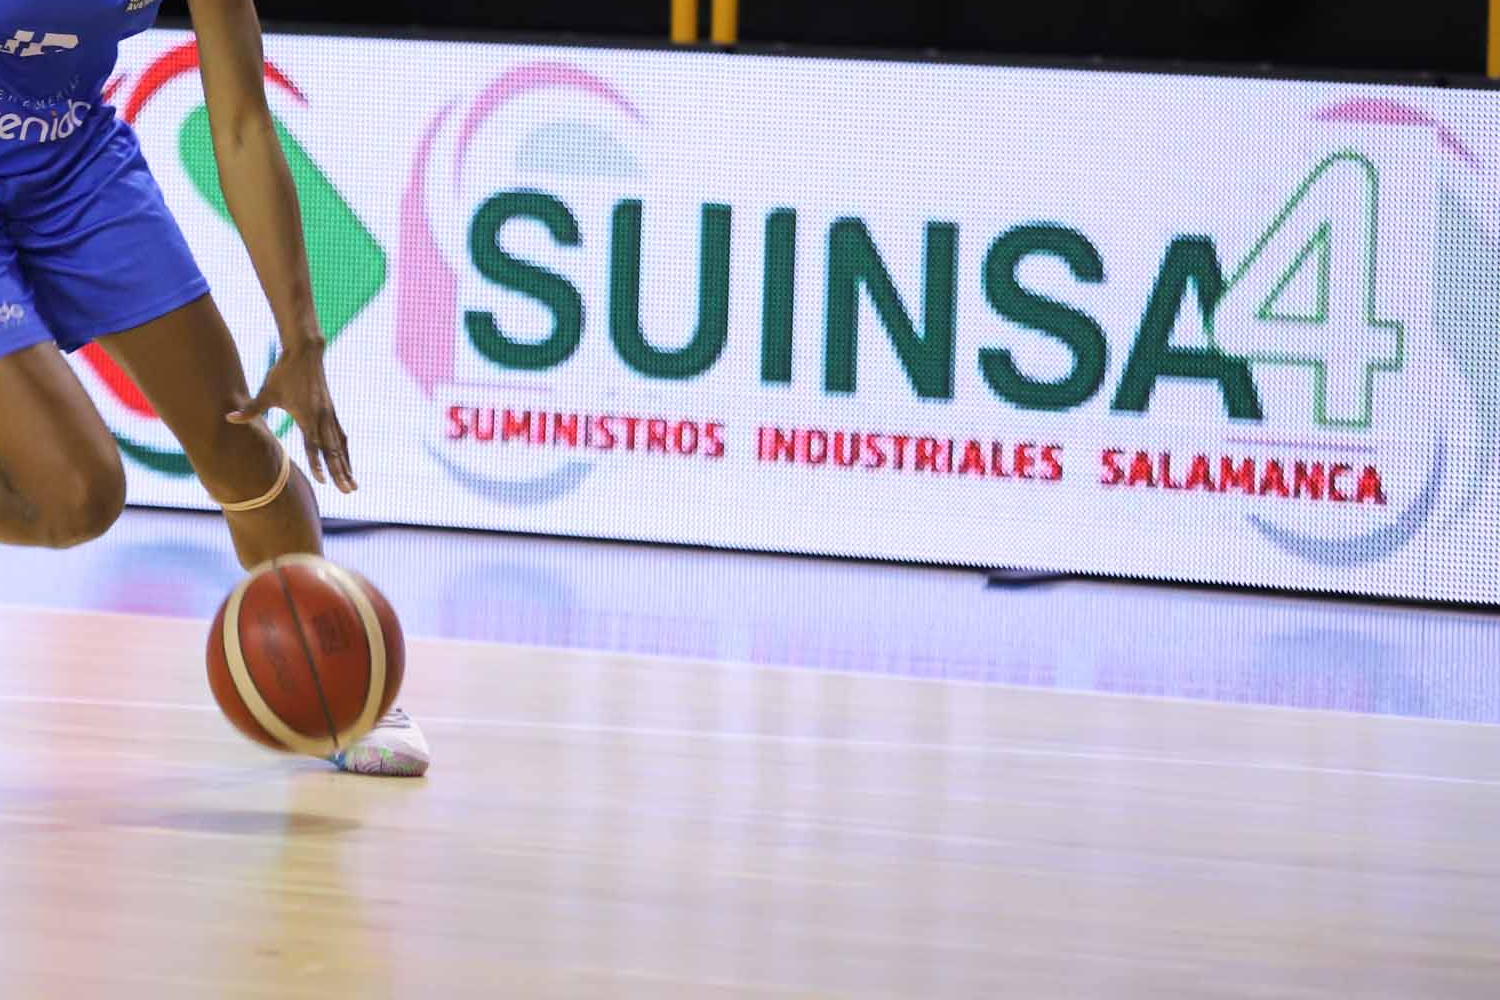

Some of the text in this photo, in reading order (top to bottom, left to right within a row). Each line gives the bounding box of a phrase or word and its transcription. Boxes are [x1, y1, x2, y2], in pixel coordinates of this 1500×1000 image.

[463, 187, 1264, 421] SUINSA
[447, 404, 1388, 506] SUMINISTROS INDUSTRIALES SALAMANCA
